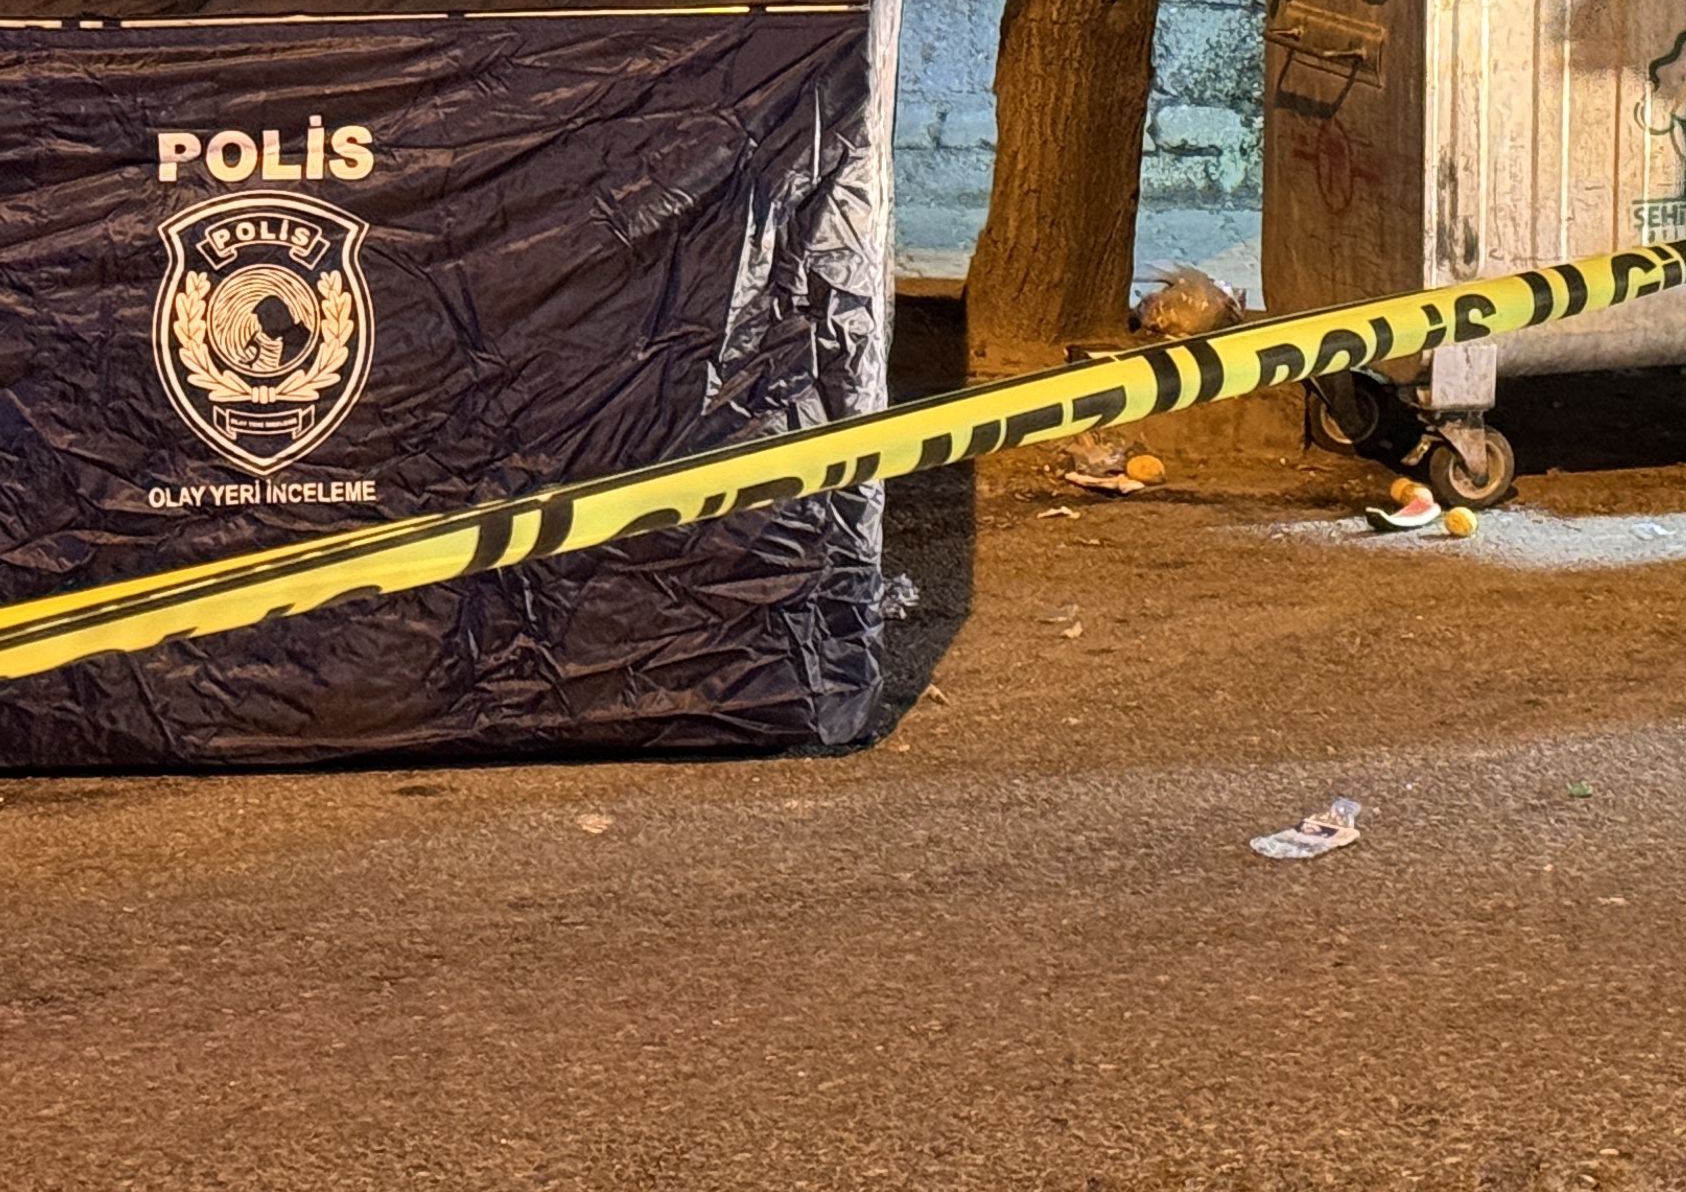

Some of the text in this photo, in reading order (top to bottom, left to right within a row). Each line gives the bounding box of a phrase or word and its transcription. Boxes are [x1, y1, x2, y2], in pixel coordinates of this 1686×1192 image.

[158, 115, 375, 182] POLİS
[213, 218, 310, 249] POLİS
[148, 477, 378, 508] OLAY YERİ İNCELEME
